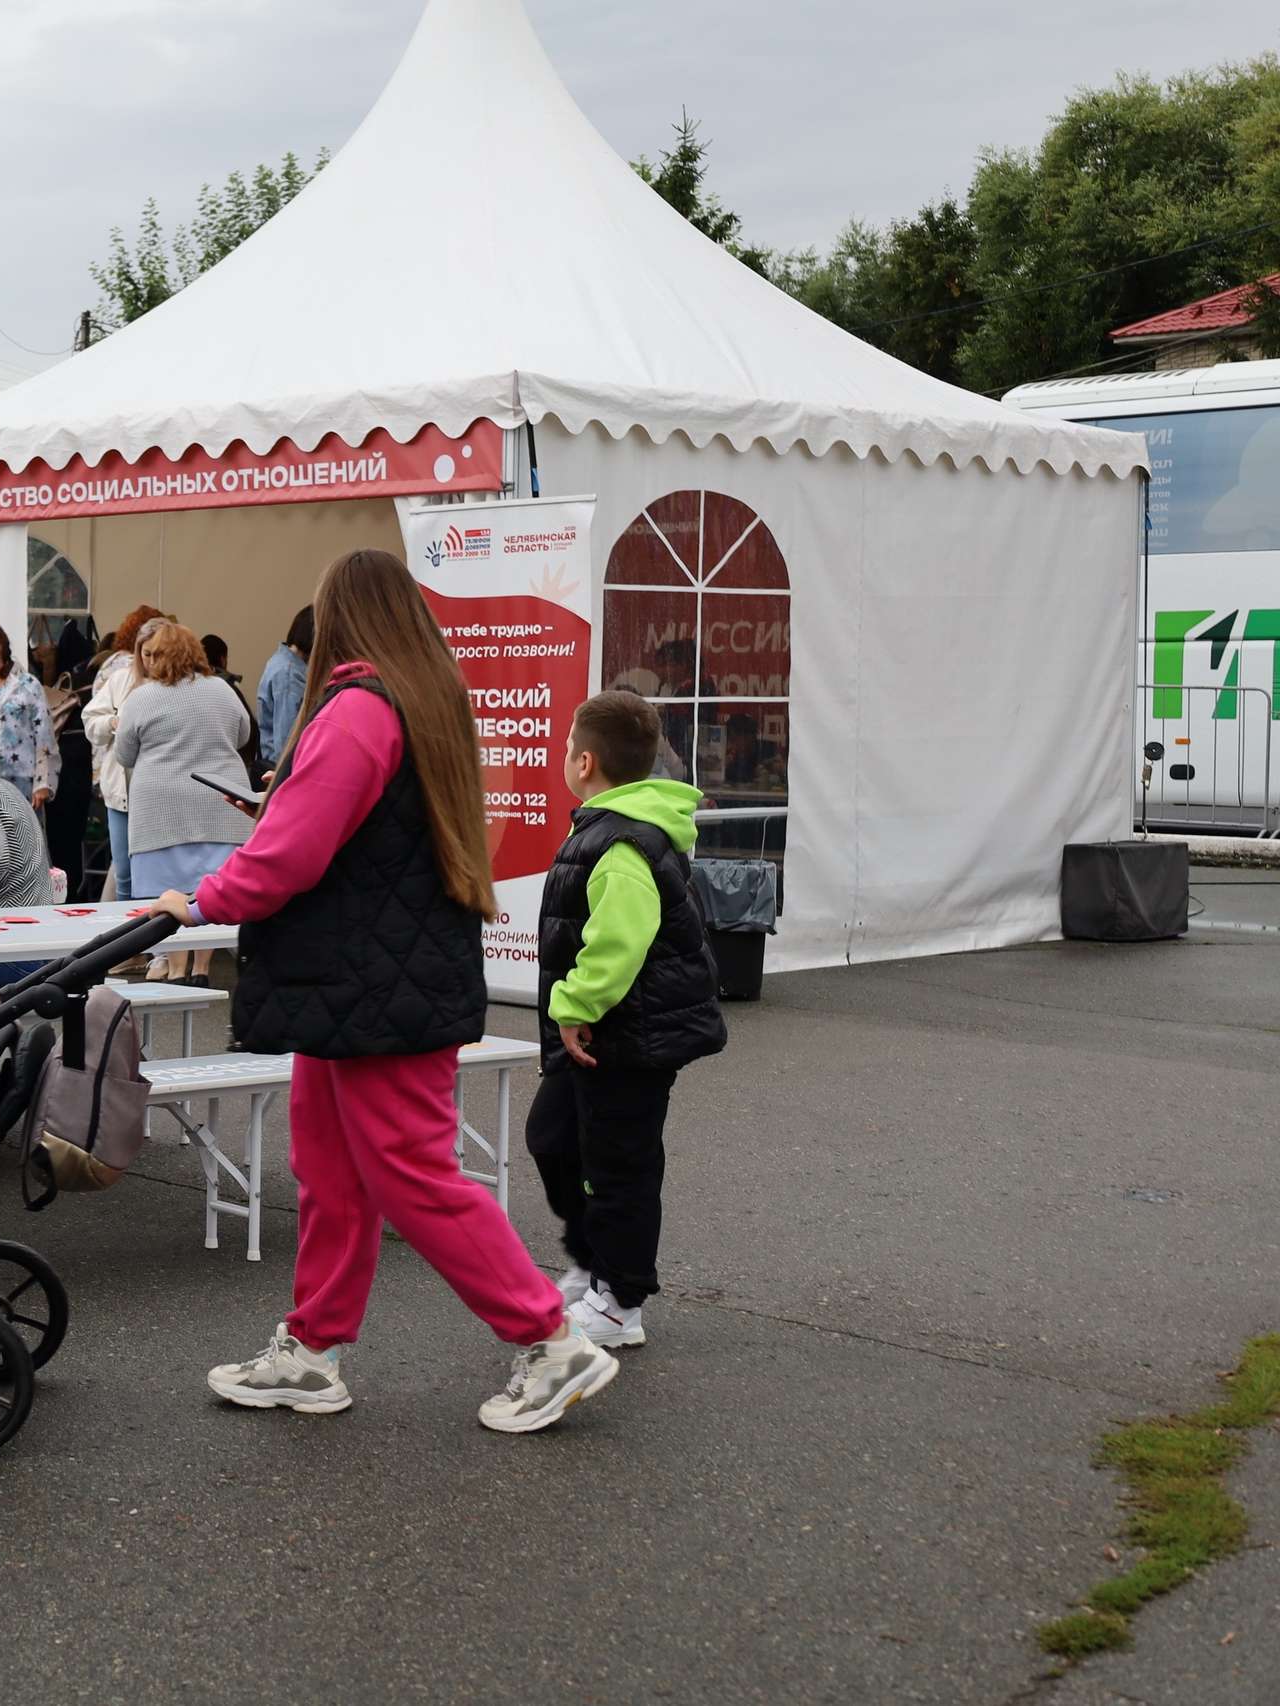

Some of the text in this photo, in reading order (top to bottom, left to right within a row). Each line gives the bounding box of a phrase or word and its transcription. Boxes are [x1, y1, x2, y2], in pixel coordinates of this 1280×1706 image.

[57, 472, 216, 505] СОЦИАЛЬНЫХ
[221, 450, 387, 493] ОТНОШЕНИЙ
[503, 532, 576, 544] ЧЕЛЯБИНСКАЯ
[503, 543, 550, 554] ОБЛАСТЬ
[454, 623, 488, 637] тебе
[489, 624, 542, 638] трудно
[503, 640, 576, 658] позвони!
[467, 682, 551, 709] ТСКИЙ
[474, 717, 551, 738] ЛЕФОН
[479, 747, 548, 767] ВЕРИЯ
[484, 792, 547, 807] 2000 122
[523, 812, 546, 826] 124
